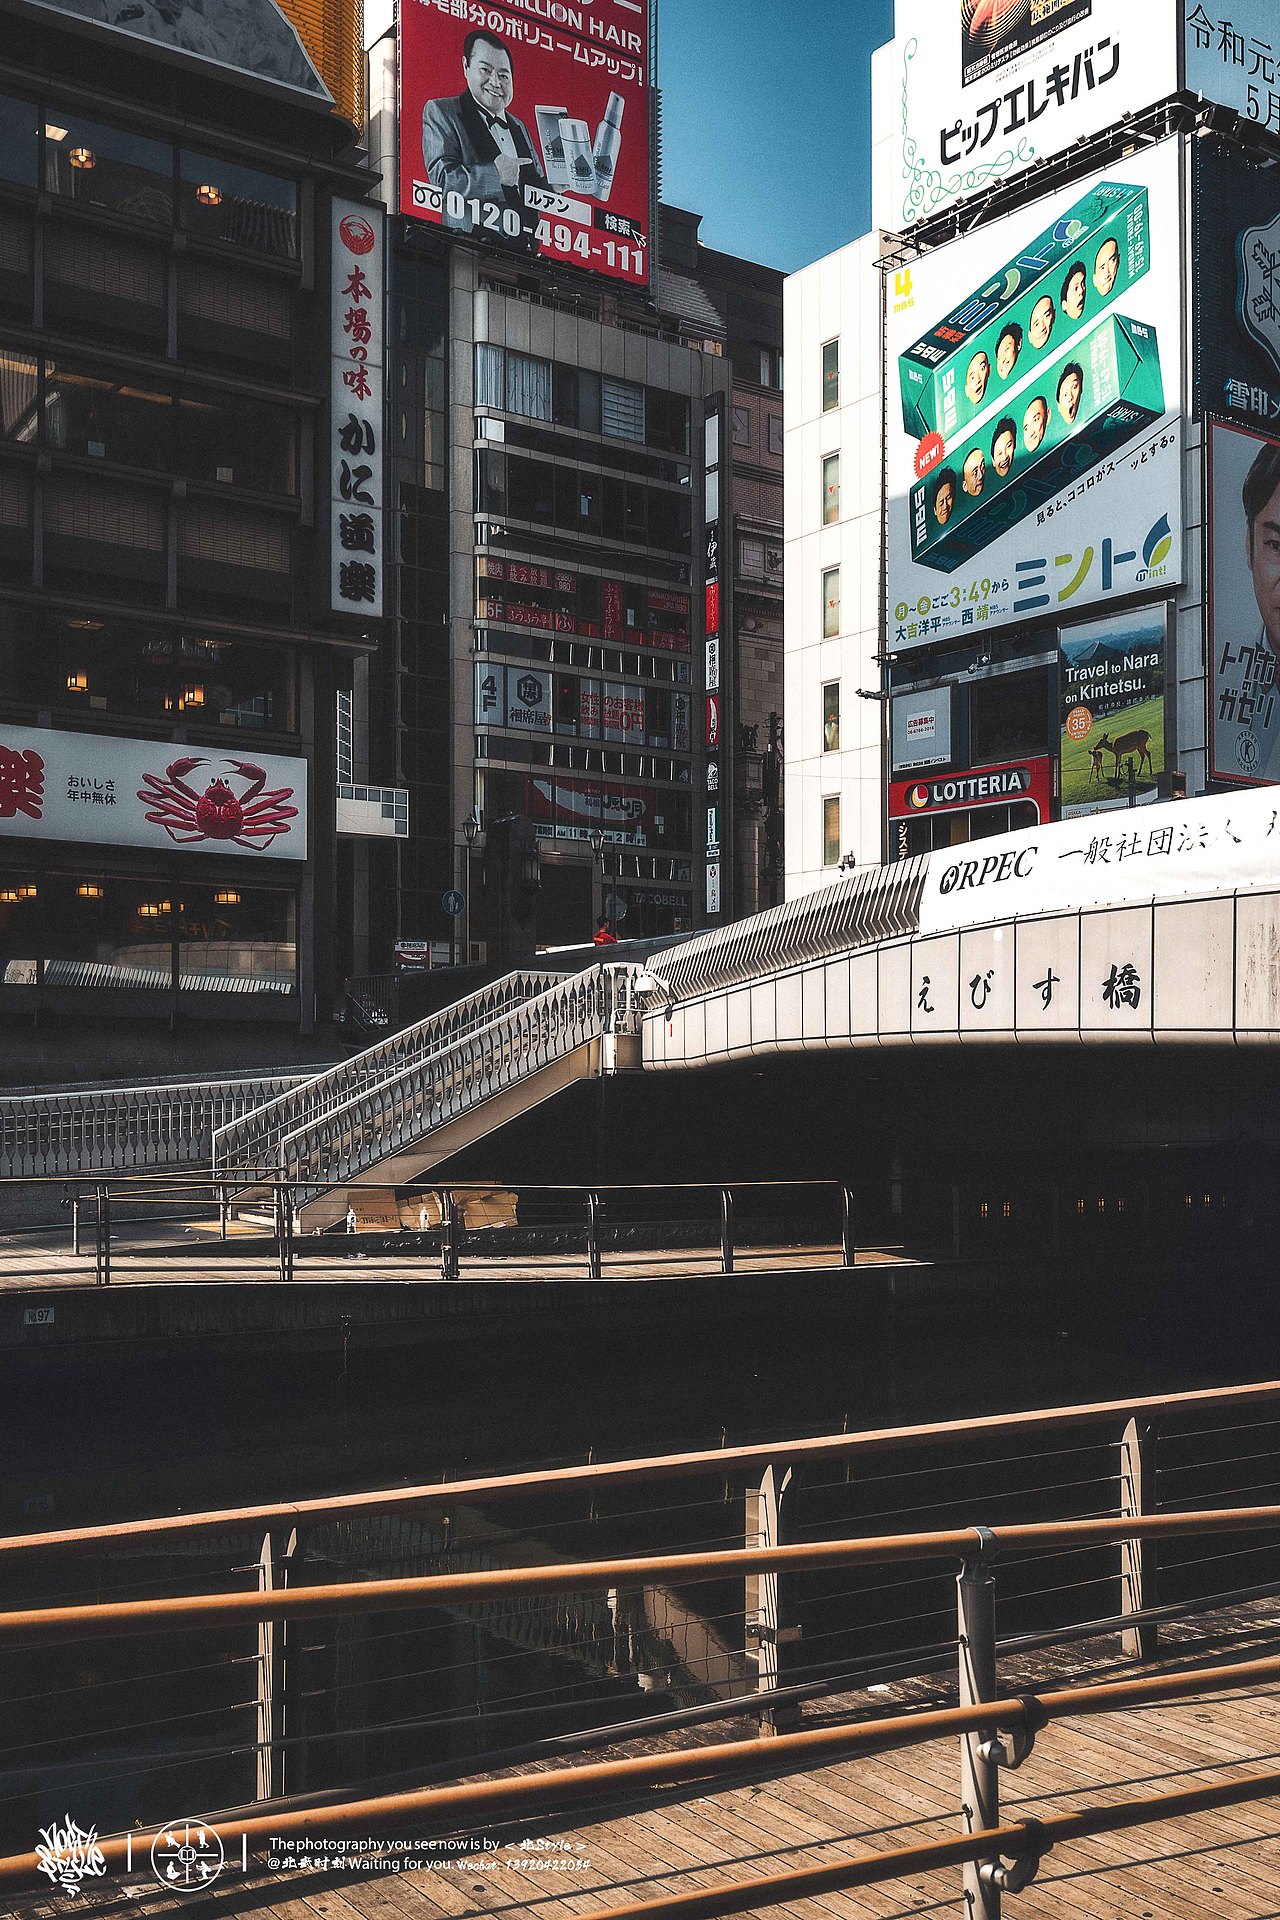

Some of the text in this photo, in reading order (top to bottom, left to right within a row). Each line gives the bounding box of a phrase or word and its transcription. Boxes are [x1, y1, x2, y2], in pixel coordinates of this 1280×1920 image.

[413, 0, 643, 87] 毛部分のボリュームアップ!
[589, 16, 642, 53] HAIR
[1186, 3, 1280, 85] 令和元
[940, 37, 1120, 166] ピップエレキバン
[528, 190, 570, 213] ルアン
[446, 190, 644, 276] 0120-494-111
[604, 213, 631, 236] 検索
[895, 269, 913, 297] 4
[341, 265, 372, 401] 本場の味
[919, 443, 940, 470] NEW!
[1013, 537, 1137, 613] ミント
[487, 602, 503, 618] 5F
[895, 616, 942, 642] 大吉洋平
[1065, 652, 1159, 683] Travel to Nara
[1218, 641, 1277, 685] トクホ
[481, 675, 497, 712] 4F
[1065, 677, 1146, 704] on Kintetsu.
[1072, 717, 1086, 731] 35
[66, 789, 117, 805] 年中無休
[67, 775, 115, 791] おいしさ
[933, 772, 1022, 802] LOTTERIA
[917, 963, 1141, 1013] えびす橋
